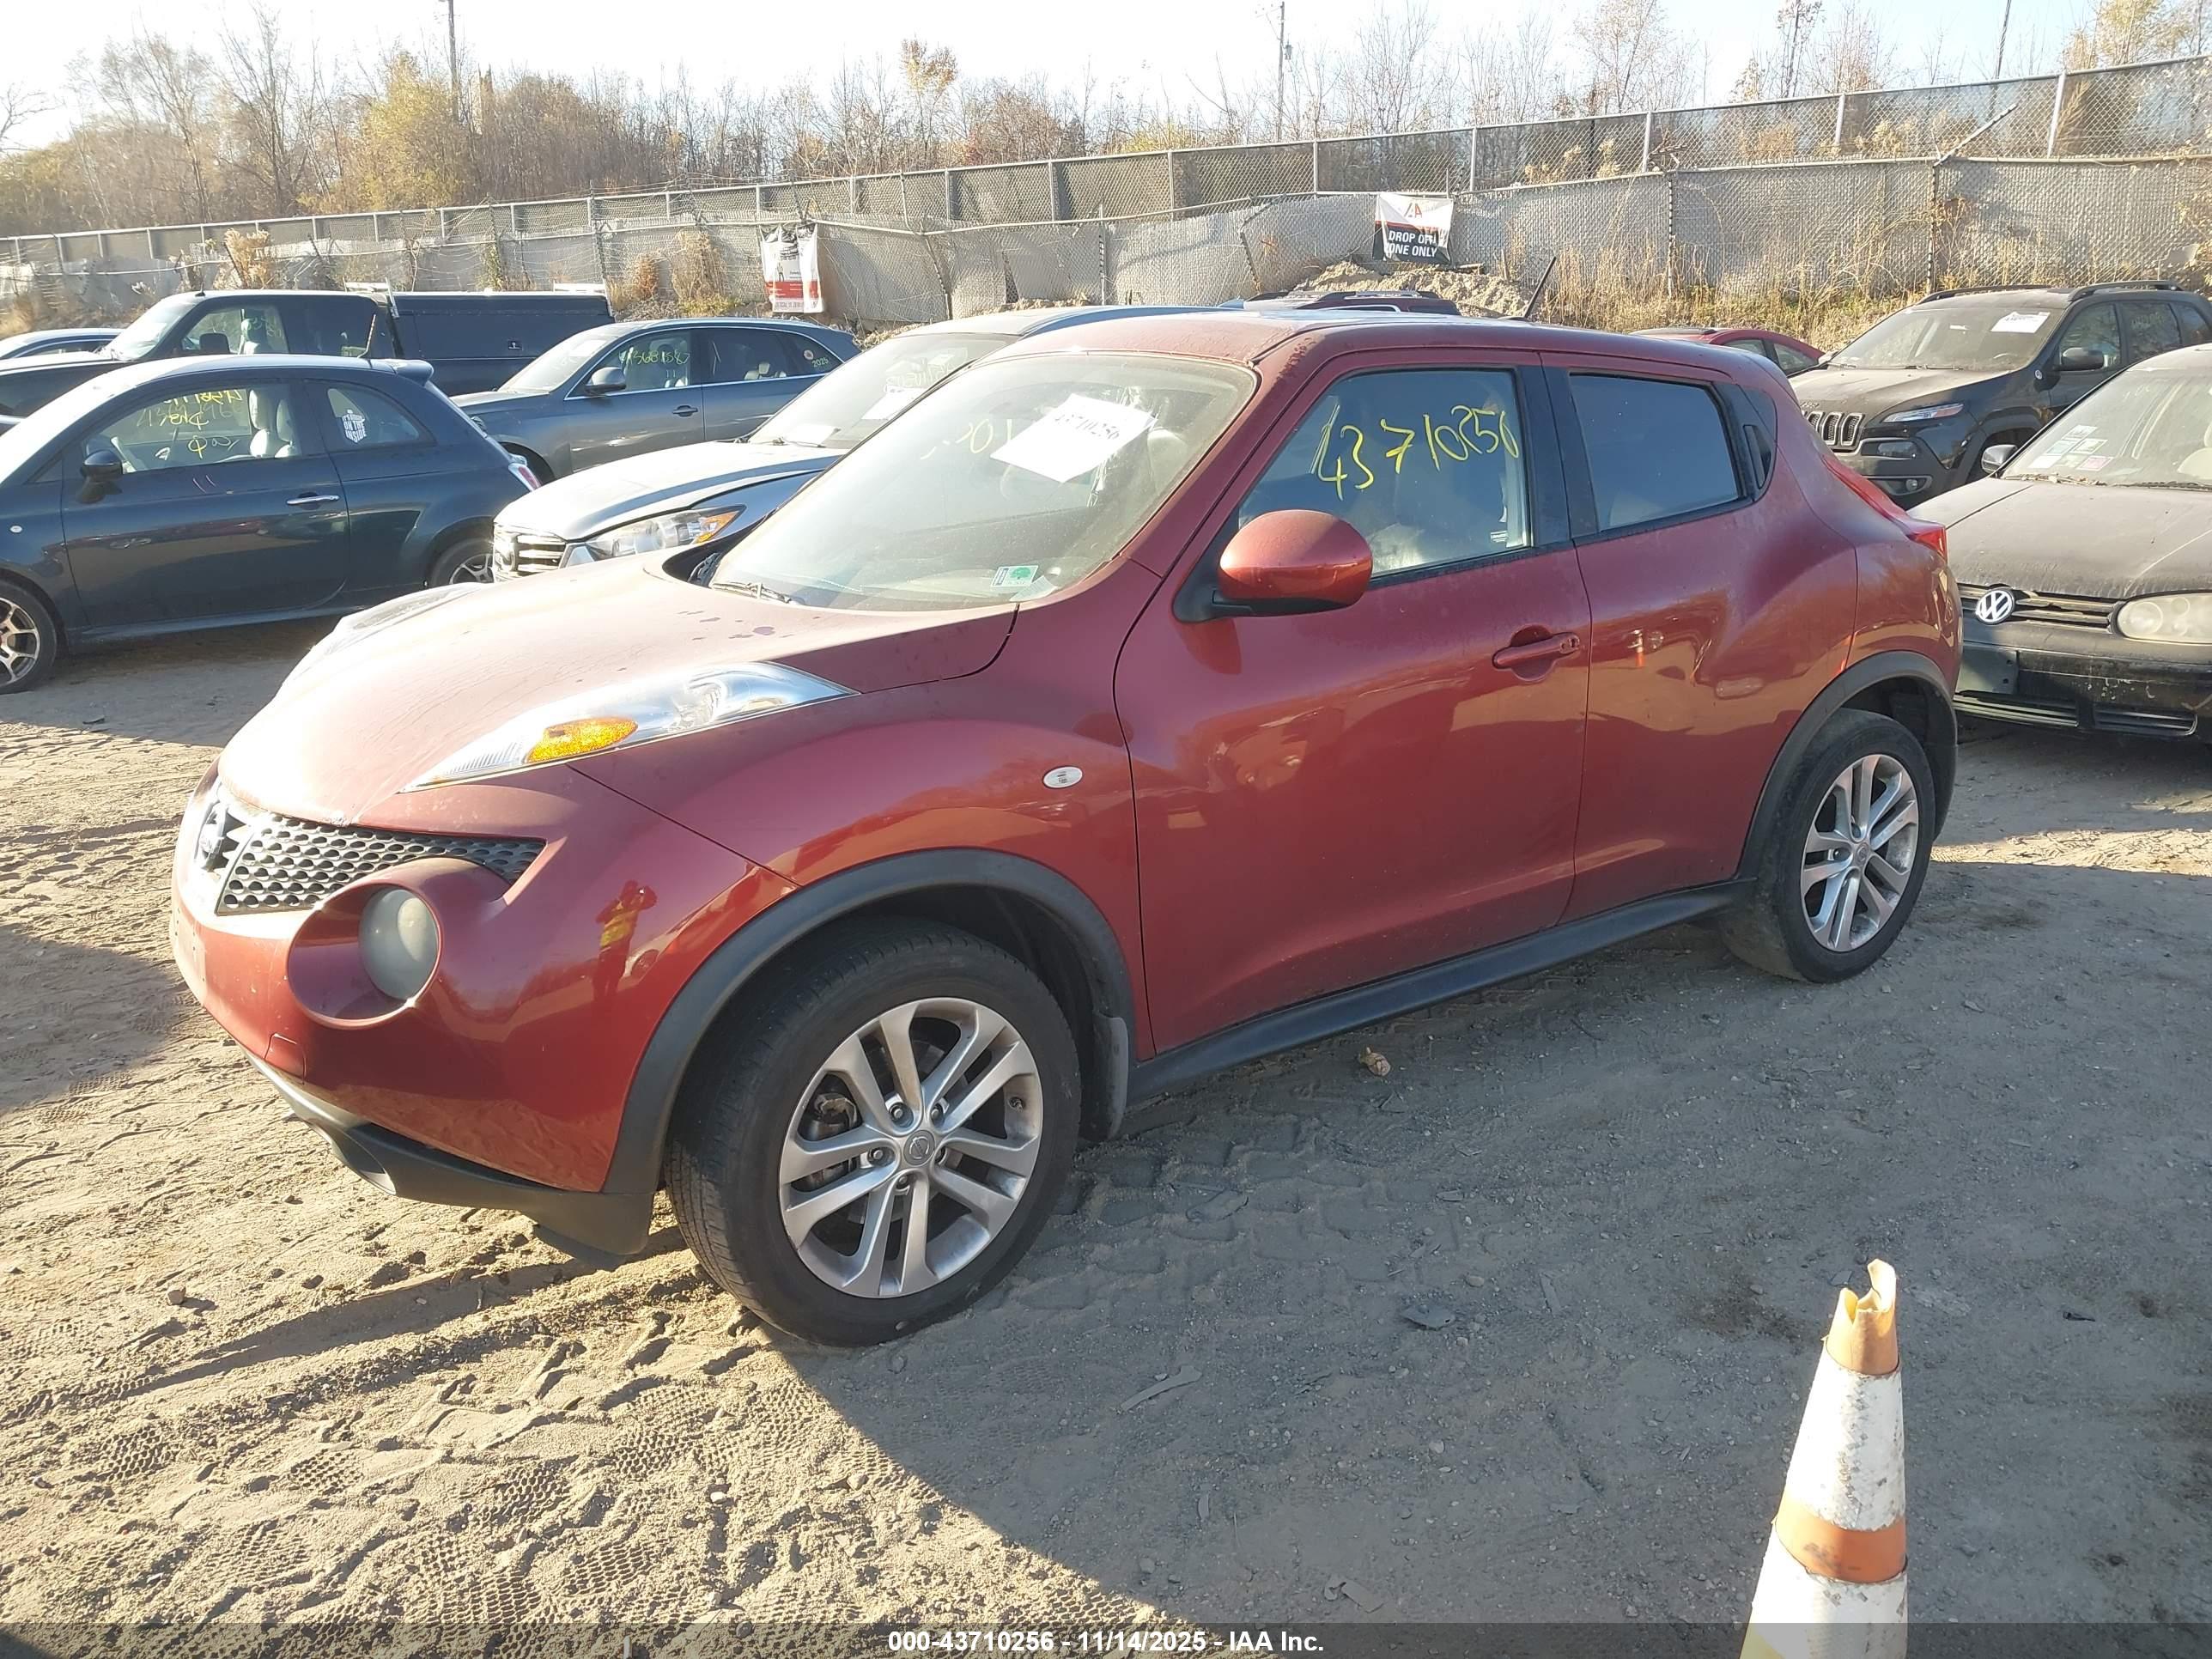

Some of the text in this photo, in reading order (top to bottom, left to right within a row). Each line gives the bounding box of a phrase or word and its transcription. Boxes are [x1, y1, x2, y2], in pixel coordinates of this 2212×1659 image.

[1389, 230, 1416, 243] DROP
[1412, 245, 1437, 258] ONLY
[345, 428, 367, 443] INSIDE
